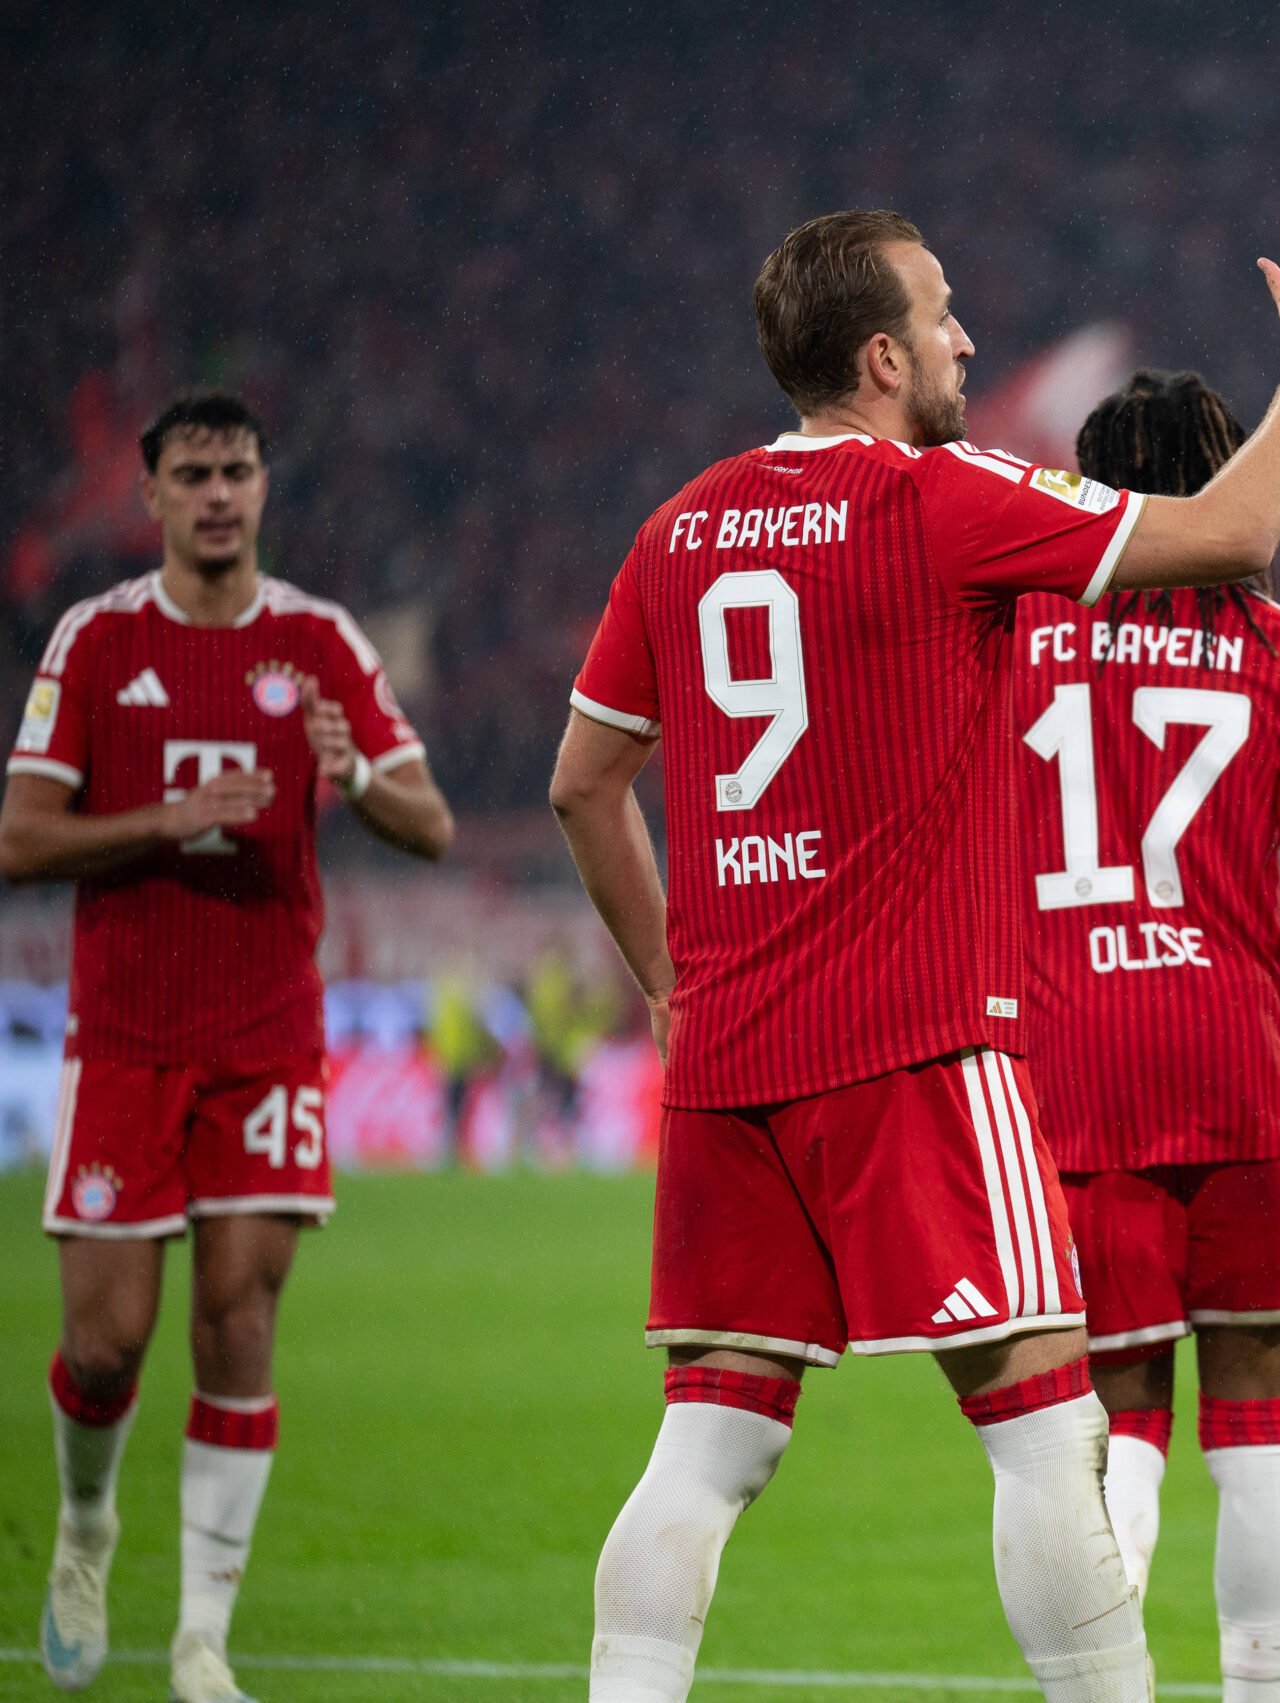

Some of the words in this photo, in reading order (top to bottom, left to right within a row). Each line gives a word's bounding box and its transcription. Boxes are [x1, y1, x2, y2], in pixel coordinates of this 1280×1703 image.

[1078, 477, 1094, 506] BUNDES
[668, 509, 710, 554] FC
[715, 499, 849, 549] BAYERN
[1030, 621, 1077, 666] FC
[1091, 620, 1244, 673] BAYERN
[698, 569, 809, 812] 9
[1022, 682, 1252, 911] 17
[715, 830, 827, 887] KANE
[1089, 922, 1212, 974] OLISE
[243, 1084, 323, 1170] 45
